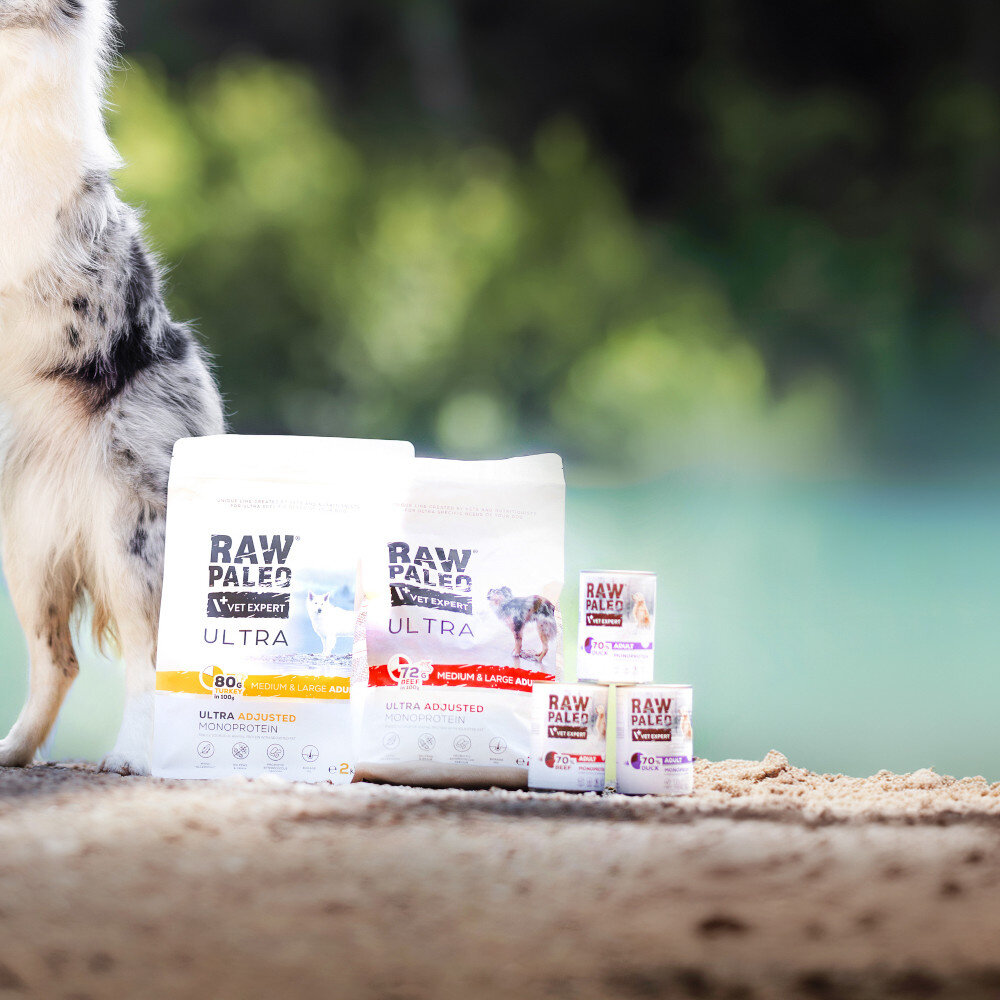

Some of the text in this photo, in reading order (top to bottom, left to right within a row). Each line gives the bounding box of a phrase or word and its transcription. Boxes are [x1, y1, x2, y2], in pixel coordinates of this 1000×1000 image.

[210, 534, 294, 565] RAW
[387, 541, 472, 573] RAW
[208, 565, 292, 588] PALEO
[388, 564, 473, 593] PALEO
[586, 582, 624, 599] RAW
[227, 603, 286, 613] VET EXPERT
[410, 593, 469, 611] VET EXPERT
[586, 599, 624, 611] PALEO
[388, 617, 475, 638] ULTRA
[203, 628, 289, 647] ULTRA
[437, 672, 533, 687] MEDIUM & LARGE ADU
[251, 682, 350, 694] MEDIUM & LARGE ADU
[386, 702, 484, 713] ULTRA ADJUSTED
[548, 694, 589, 712] RAW
[631, 698, 672, 714] RAW
[199, 711, 296, 723] ULTRA ADJUSTED
[385, 713, 466, 724] MONOPROTEIN
[548, 711, 589, 725] PALEO
[631, 715, 672, 726] PALEO
[198, 722, 278, 734] MONOPROTEIN
